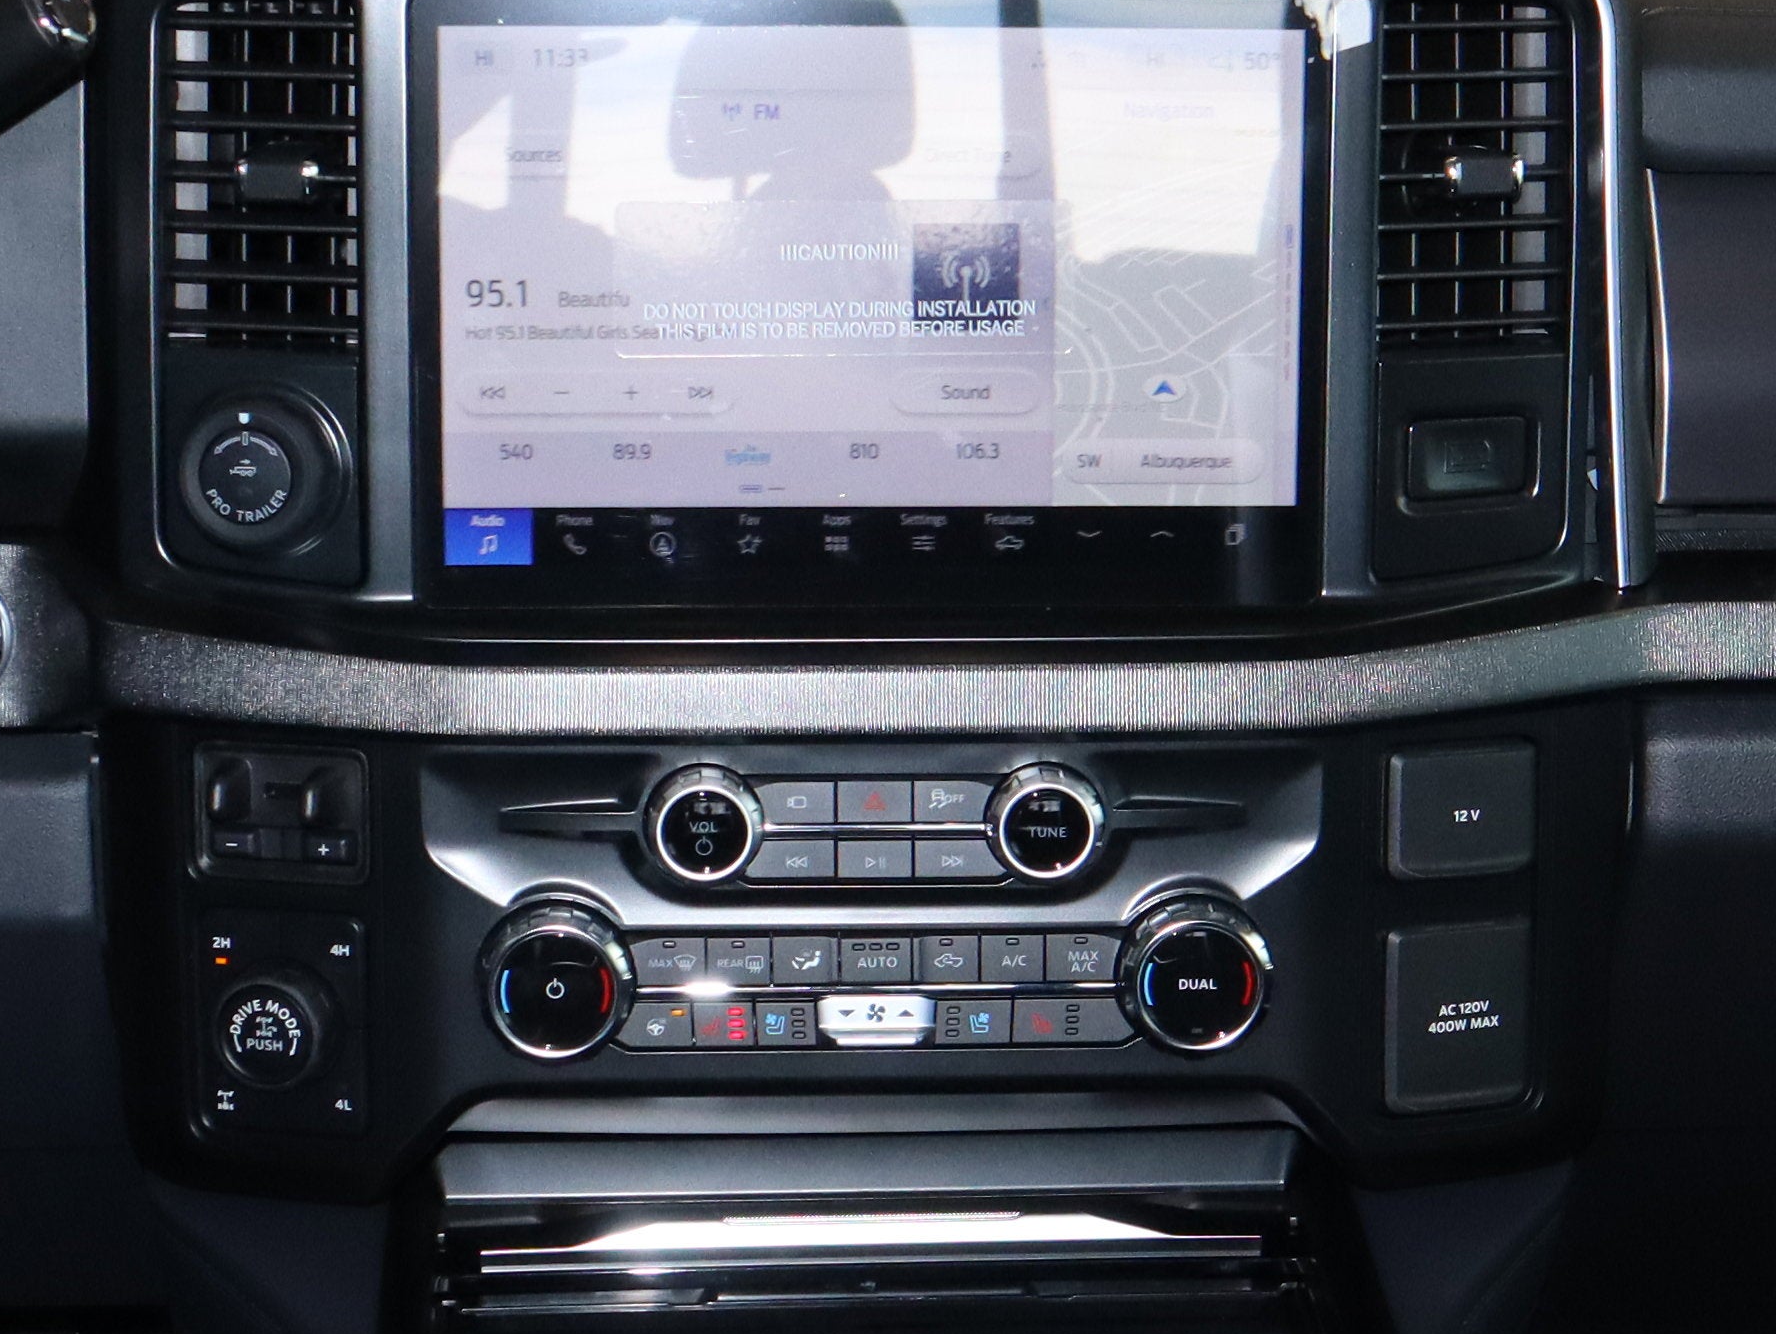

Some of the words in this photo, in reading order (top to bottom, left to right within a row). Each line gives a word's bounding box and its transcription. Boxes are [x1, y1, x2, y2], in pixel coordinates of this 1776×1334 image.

[754, 104, 781, 120] FM
[465, 279, 529, 308] 95.1
[643, 302, 670, 320] DO
[672, 302, 708, 320] NOT
[711, 302, 771, 320] TOUCH
[775, 300, 846, 319] DISPLAY
[849, 300, 914, 318] DURING
[917, 298, 1036, 318] INSTALLATION
[656, 322, 694, 340] THIS
[696, 322, 738, 339] FILM
[741, 322, 758, 339] IS
[760, 321, 785, 338] TO
[786, 321, 809, 338] BE
[812, 320, 896, 338] REMOVED
[899, 319, 966, 338] BEFORE
[968, 318, 1026, 338] USAGE
[941, 384, 991, 400] Sound
[499, 443, 534, 460] 540
[612, 443, 652, 460] 89.9
[849, 443, 880, 460] 810
[956, 442, 1000, 459] 106.3
[1076, 454, 1102, 468] SW
[1140, 453, 1233, 471] Albuquerque
[205, 488, 232, 517] PRO
[236, 488, 288, 523] TRAILER
[470, 515, 506, 528] Audio
[556, 515, 594, 527] Phone
[738, 514, 762, 527] Fav
[900, 513, 948, 528] Settings
[984, 513, 1035, 527] Features
[943, 793, 965, 805] OFF
[1452, 809, 1468, 823] 12
[1469, 809, 1481, 822] V
[689, 821, 719, 834] VOL
[1028, 826, 1067, 839] TUNE
[212, 936, 231, 949] 2H
[329, 944, 350, 957] 4H
[1067, 950, 1099, 963] MAX
[648, 957, 673, 968] MAX
[717, 957, 744, 968] REAR
[857, 956, 898, 968] AUTO
[1001, 954, 1027, 967] A/C
[1070, 959, 1096, 973] A/C
[1177, 977, 1218, 991] DUAL
[1437, 1004, 1457, 1017] AC
[1458, 1000, 1490, 1016] 120V
[229, 999, 263, 1035] DRIVE
[265, 999, 301, 1038] MODE
[1427, 1018, 1468, 1035] 400W
[1469, 1014, 1500, 1030] MAX
[246, 1037, 283, 1053] PUSH
[334, 1098, 352, 1111] 4L
